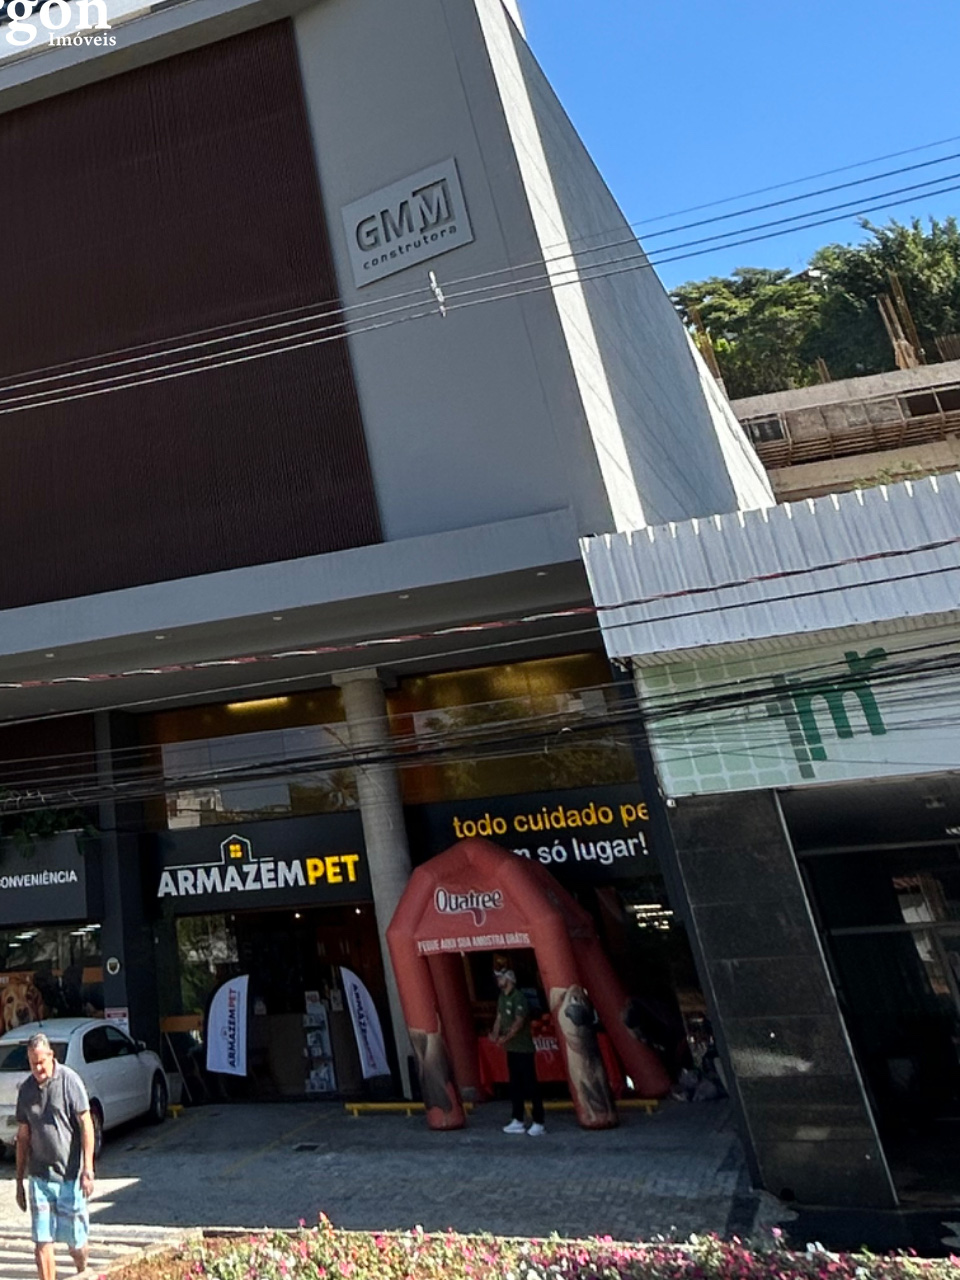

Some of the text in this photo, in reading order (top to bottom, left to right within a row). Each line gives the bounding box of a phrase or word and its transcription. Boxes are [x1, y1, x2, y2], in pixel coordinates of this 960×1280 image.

[355, 177, 456, 252] GMM
[363, 225, 457, 270] construtora
[453, 812, 508, 839] todo
[513, 801, 614, 833] cuidado
[537, 839, 568, 864] só
[571, 831, 650, 866] lugar!
